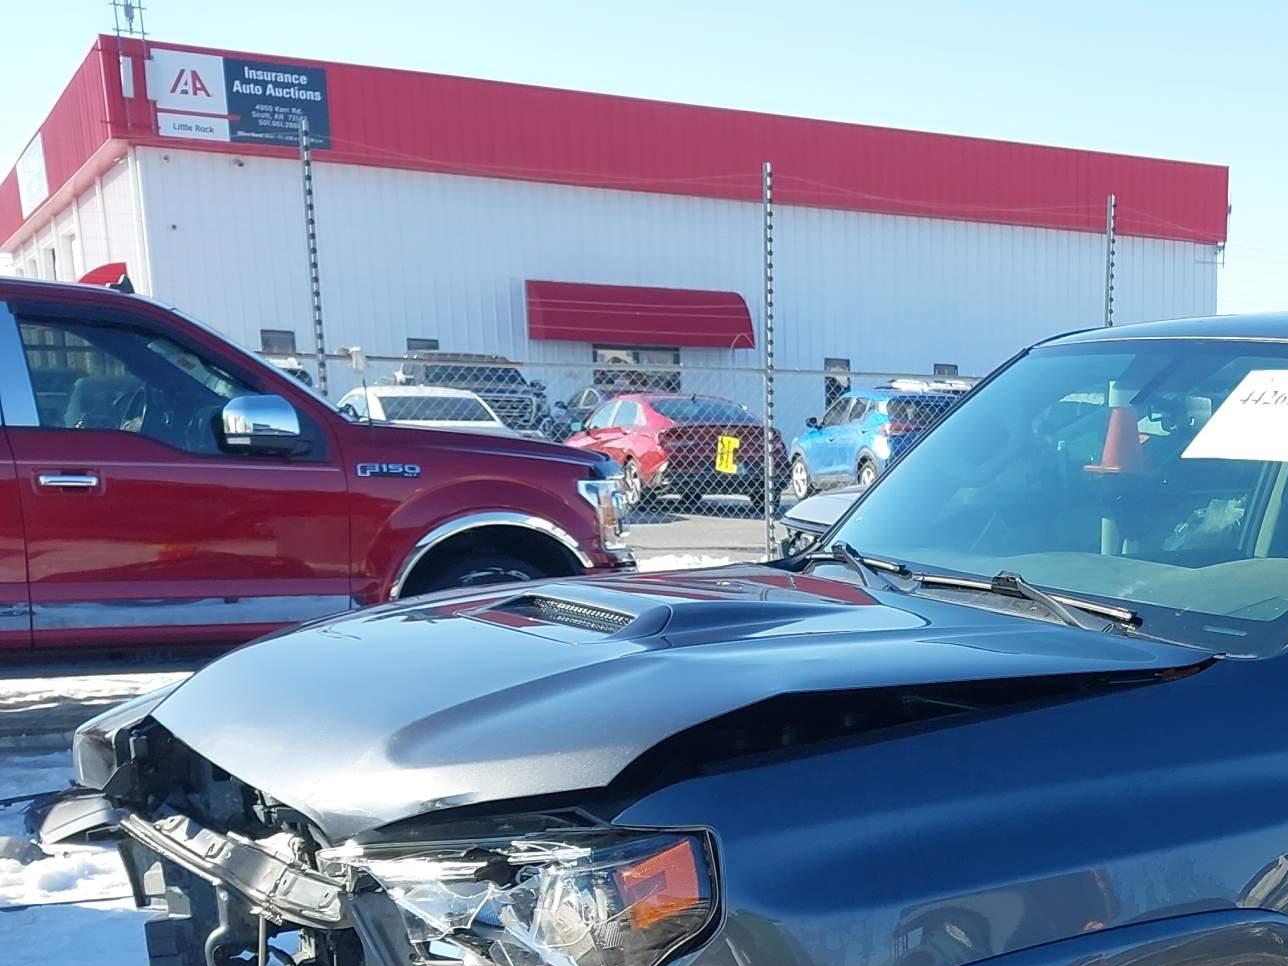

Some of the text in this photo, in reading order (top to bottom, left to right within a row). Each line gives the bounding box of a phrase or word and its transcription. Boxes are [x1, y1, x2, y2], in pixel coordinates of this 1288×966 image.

[243, 66, 308, 85] Insurance
[232, 80, 322, 101] Auto Auctions
[172, 122, 214, 134] Little Rock
